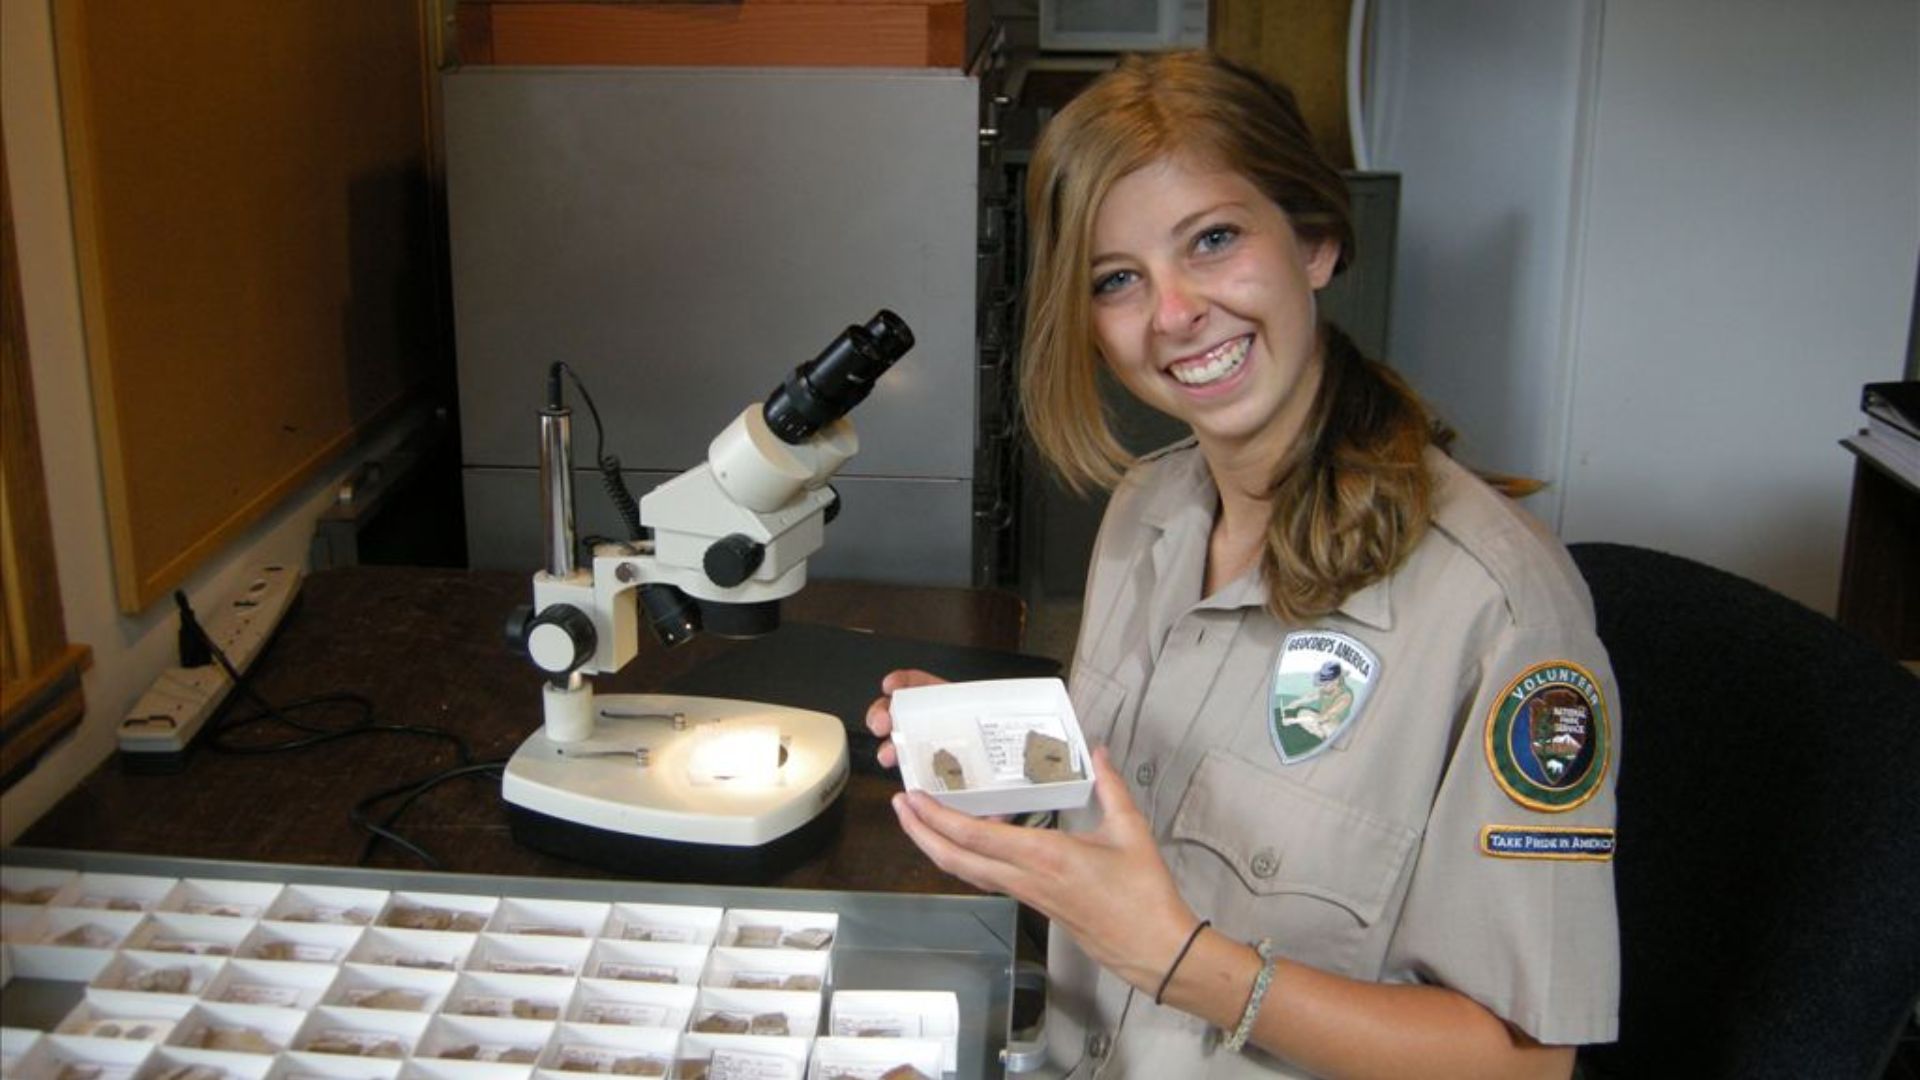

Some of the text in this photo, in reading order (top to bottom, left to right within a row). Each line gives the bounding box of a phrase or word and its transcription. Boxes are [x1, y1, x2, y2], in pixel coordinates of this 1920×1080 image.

[1288, 637, 1371, 677] GEOCORPS AMERICA
[1512, 668, 1599, 705] VOLUNTEER
[1490, 835, 1523, 848] TAKE
[1525, 835, 1557, 849] PRIDE
